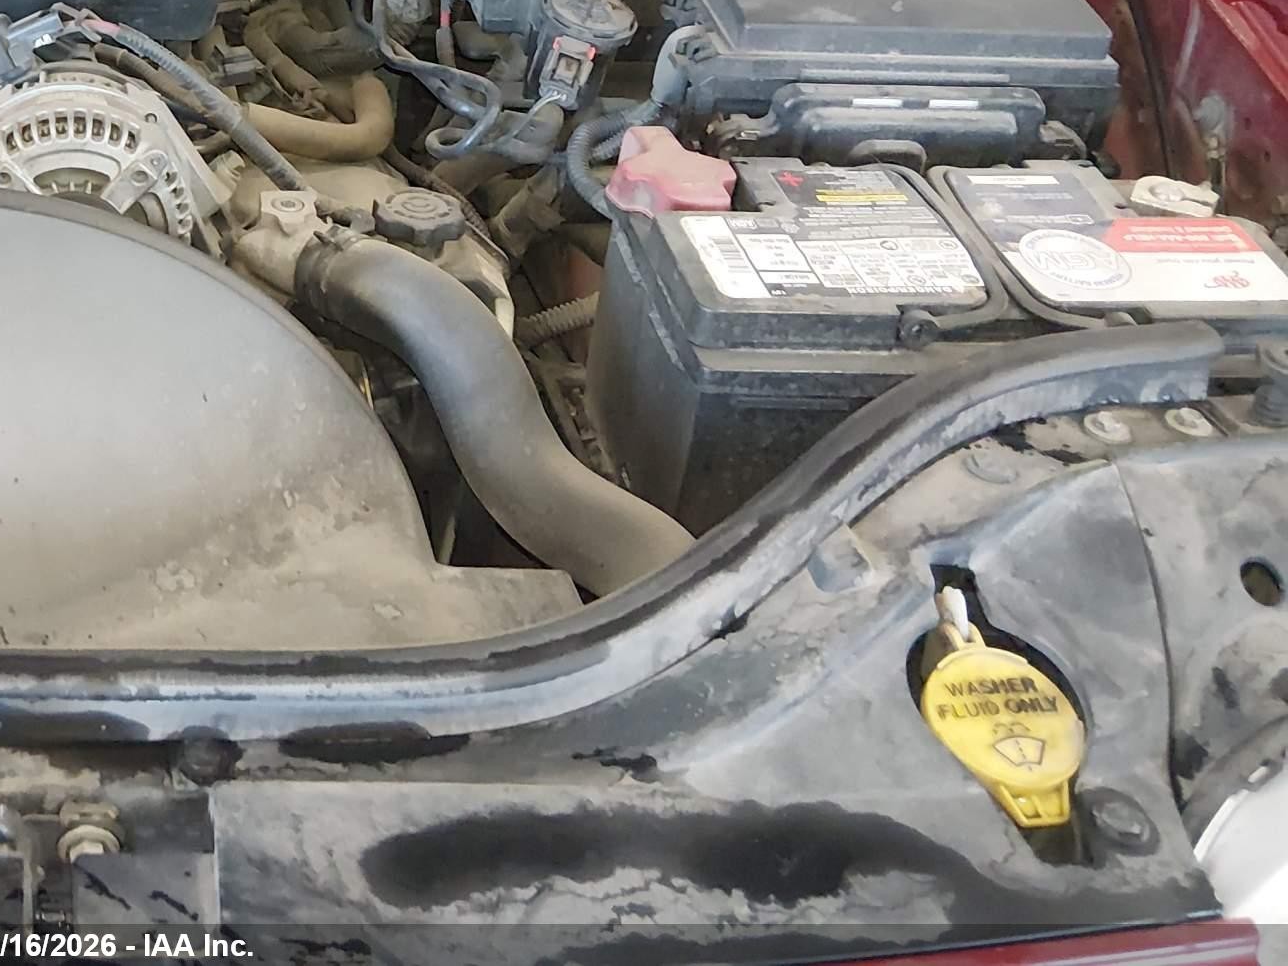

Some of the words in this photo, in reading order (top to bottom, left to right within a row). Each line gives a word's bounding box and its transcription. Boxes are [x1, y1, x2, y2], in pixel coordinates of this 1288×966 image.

[943, 676, 1039, 697] WASHER
[936, 698, 1001, 720] FLUID
[1003, 695, 1059, 714] ONLY
